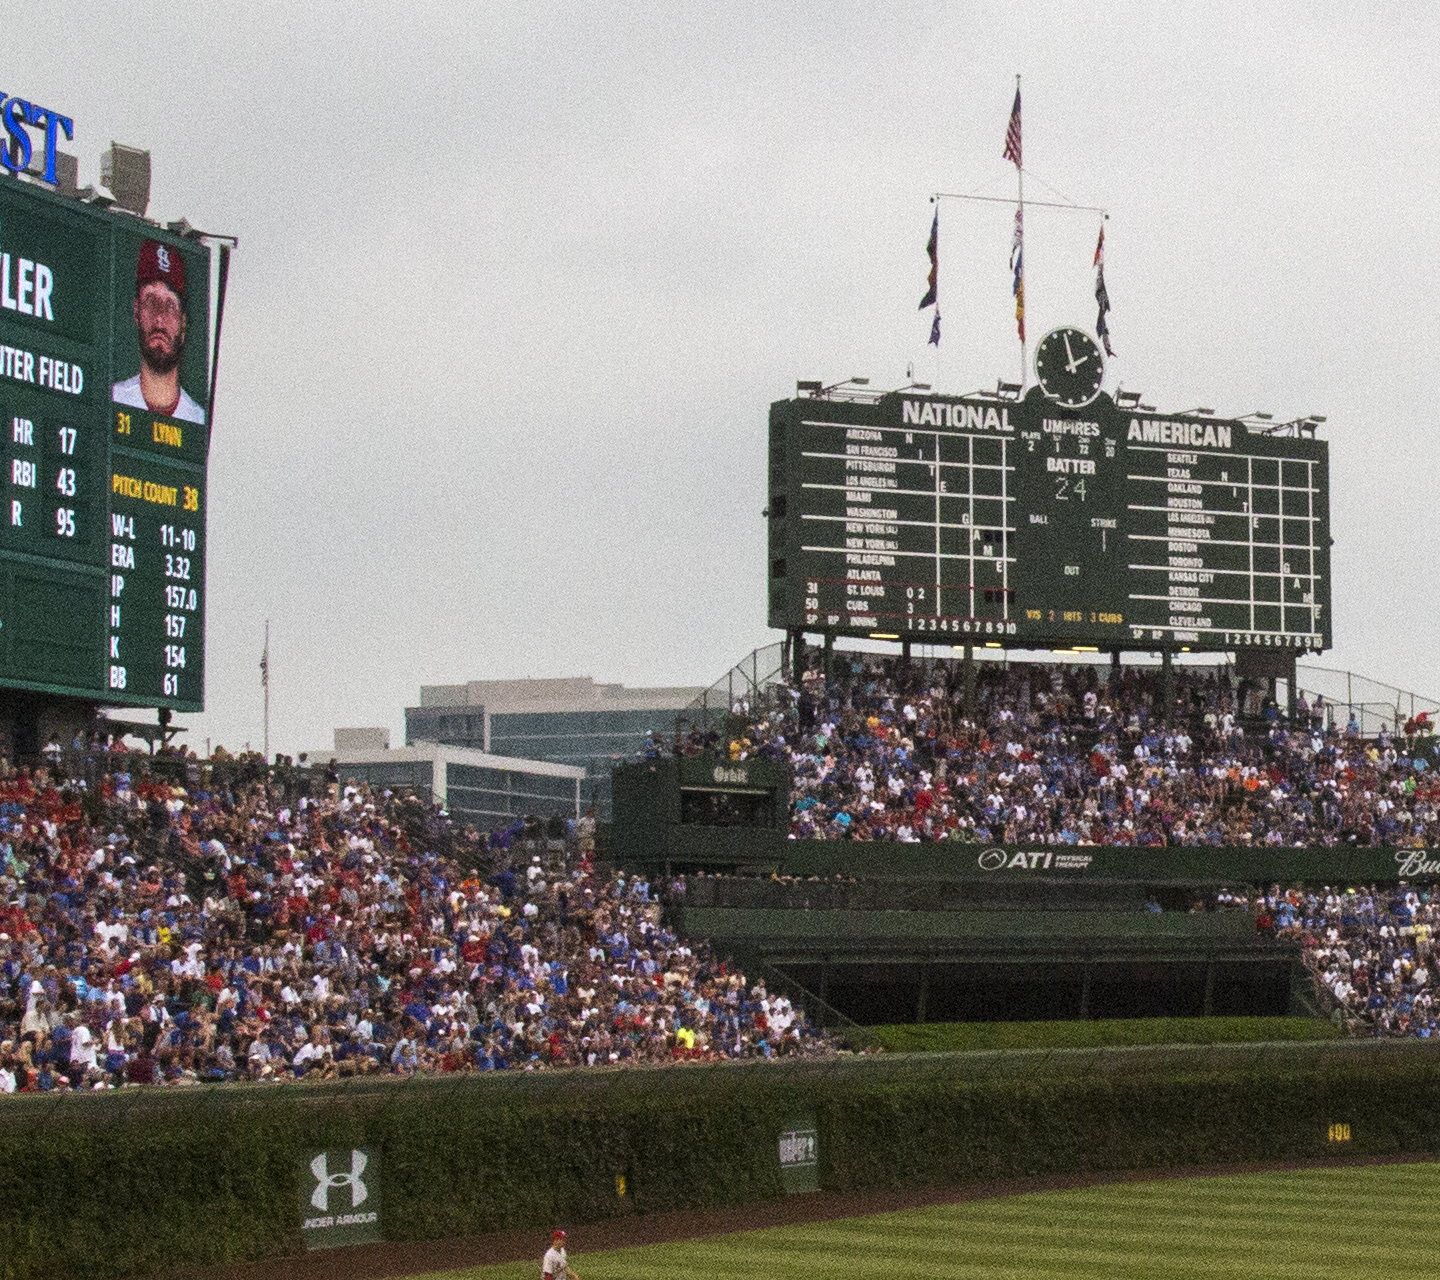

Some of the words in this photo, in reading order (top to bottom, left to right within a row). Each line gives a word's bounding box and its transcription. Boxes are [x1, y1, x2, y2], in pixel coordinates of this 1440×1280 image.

[39, 356, 83, 395] FIELD
[902, 400, 1014, 431] NATIONAL
[13, 417, 33, 446] HR
[59, 426, 77, 455] 17
[117, 412, 131, 435] 31
[152, 421, 182, 447] LYNN
[1043, 419, 1100, 436] UMPIRES
[1127, 419, 1232, 448] AMERICAN
[846, 460, 896, 473] PITTSBURGH
[1046, 457, 1096, 475] BATTER
[1167, 468, 1190, 478] TEXAS
[12, 458, 36, 488] RBI
[56, 467, 76, 497] 43
[112, 474, 142, 499] PITCH
[144, 481, 177, 507] COUNT
[183, 486, 198, 511] 38
[1056, 477, 1086, 501] 24
[1168, 483, 1203, 494] OAKLAND
[11, 500, 22, 526] R
[56, 508, 76, 537] 95
[112, 513, 136, 539] W-L
[160, 524, 196, 551] 11-10
[1169, 542, 1197, 553] BOSTON
[111, 544, 135, 569] ERA
[165, 554, 190, 580] 3.32
[1169, 557, 1203, 568] TORONTO
[847, 569, 881, 581] ATLANTA
[1169, 572, 1197, 582] KANSAS
[1199, 573, 1214, 584] CITY
[111, 575, 124, 597] IP
[165, 585, 197, 611] 157.0
[807, 582, 818, 594] 31
[1169, 587, 1199, 597] DETROIT
[805, 598, 818, 610] 50
[847, 601, 869, 611] CUBS
[1169, 602, 1202, 612] CHICAGO
[110, 605, 120, 627] H
[165, 614, 186, 638] 157
[1169, 616, 1211, 627] CLEVELAND
[110, 636, 119, 658] K
[164, 644, 185, 668] 154
[110, 665, 126, 689] BB
[163, 673, 178, 696] 61
[1007, 852, 1053, 869] ATI
